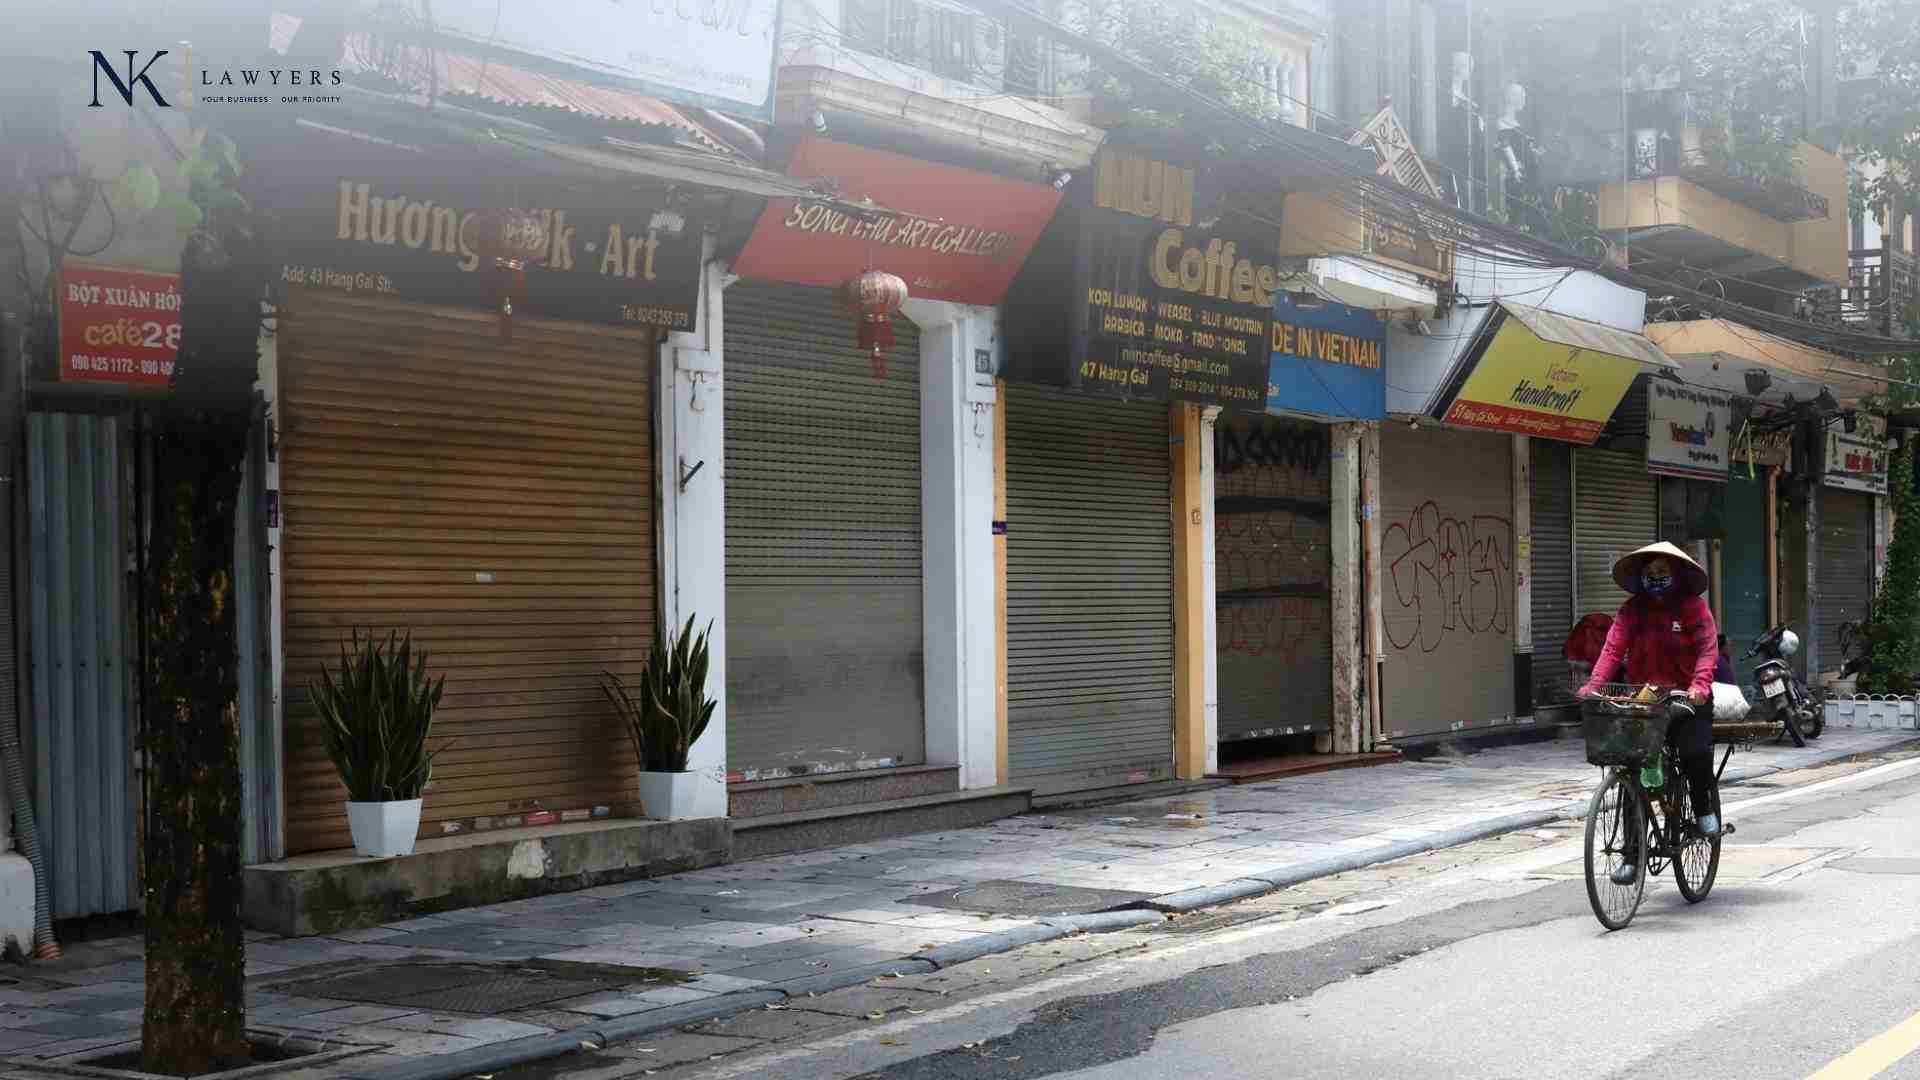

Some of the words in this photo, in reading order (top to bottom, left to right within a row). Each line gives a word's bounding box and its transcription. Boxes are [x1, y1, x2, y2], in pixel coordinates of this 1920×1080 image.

[600, 223, 660, 281] Art
[1150, 228, 1279, 309] Coffee
[1087, 286, 1112, 307] KOPI
[1153, 323, 1184, 344] MOKA
[1297, 326, 1312, 358] IN
[1316, 330, 1381, 369] VIETNAM
[1079, 360, 1096, 377] 47
